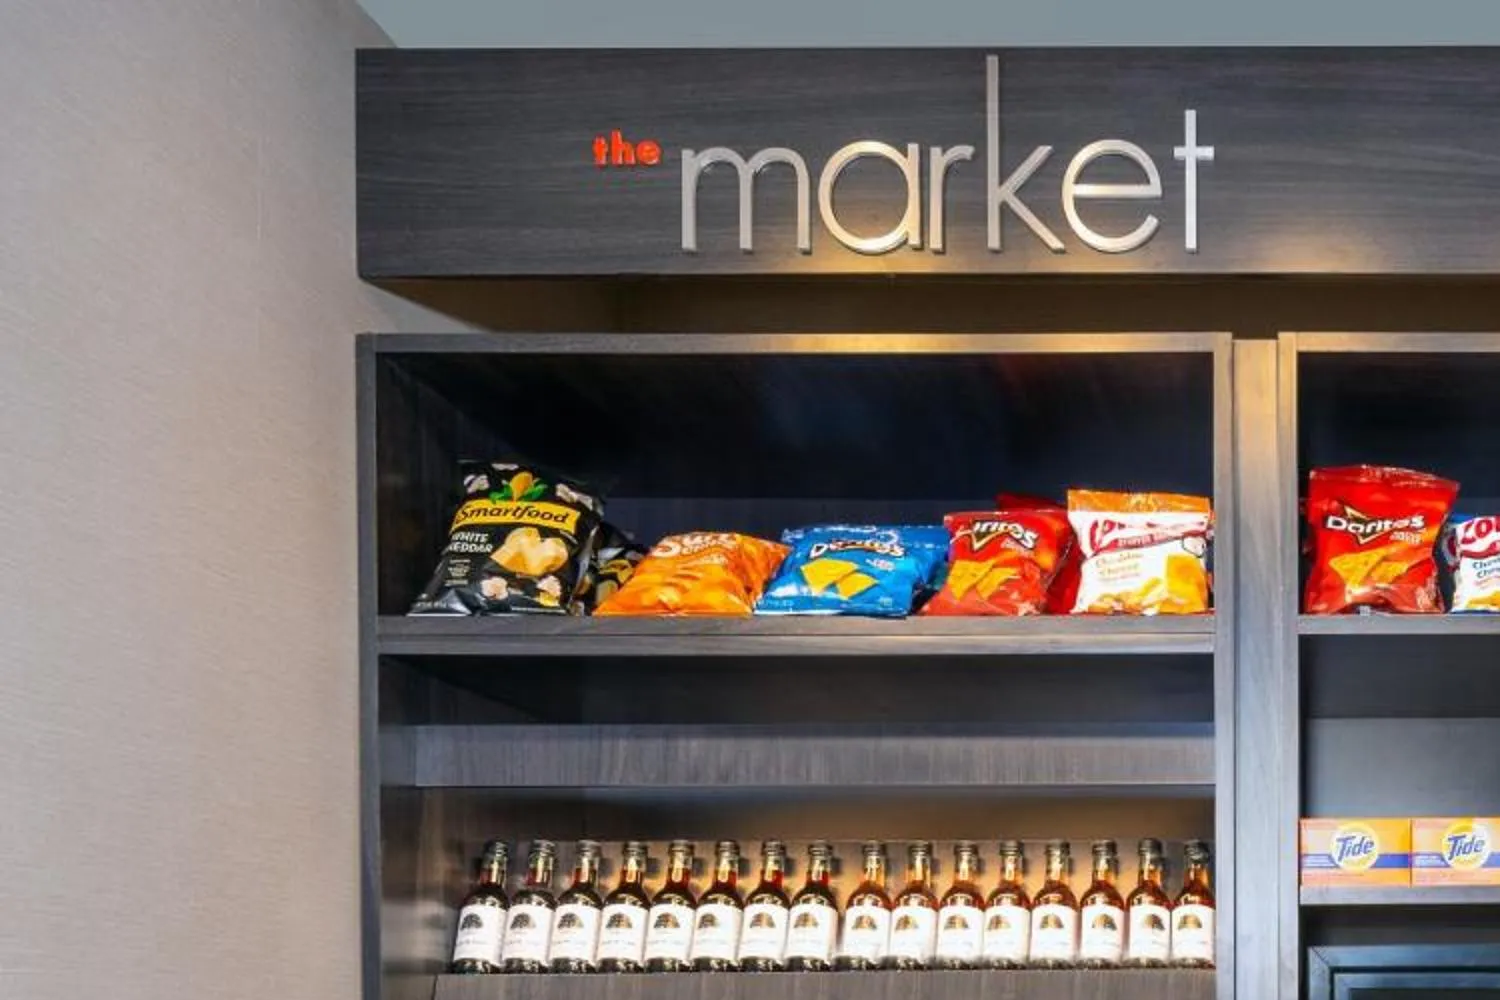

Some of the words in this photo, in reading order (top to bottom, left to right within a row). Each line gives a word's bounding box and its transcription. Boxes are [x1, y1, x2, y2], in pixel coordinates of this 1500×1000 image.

[593, 131, 661, 167] the
[681, 54, 1215, 254] market
[460, 505, 569, 523] Smartfood
[1327, 515, 1425, 534] Doritos
[1336, 836, 1374, 862] Tide
[1448, 834, 1486, 860] Tide
